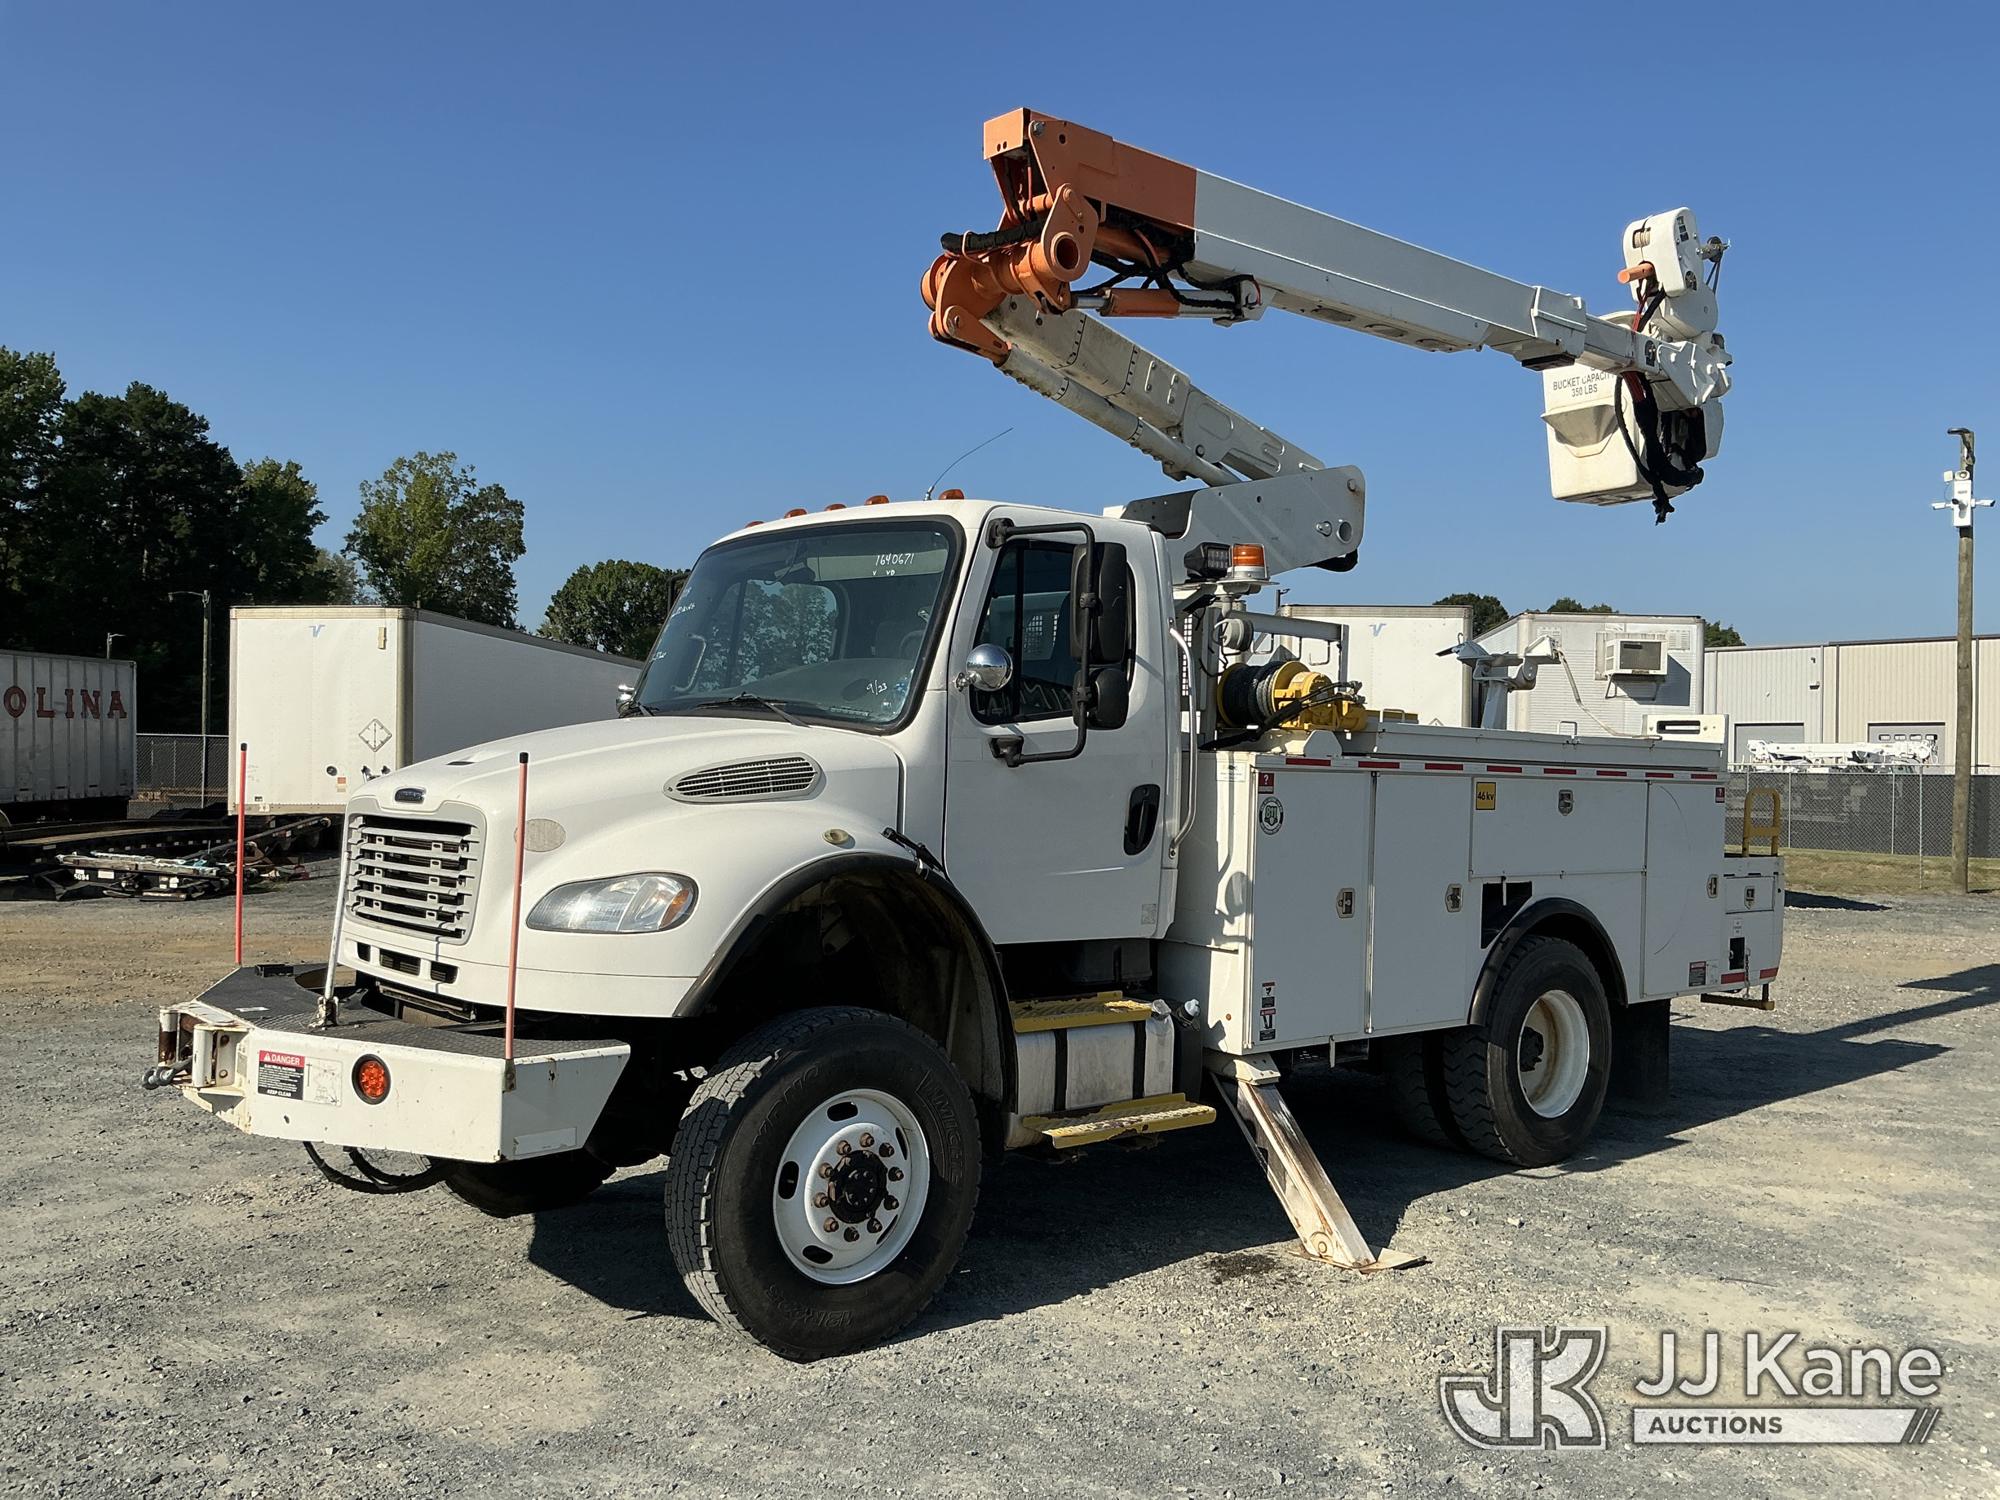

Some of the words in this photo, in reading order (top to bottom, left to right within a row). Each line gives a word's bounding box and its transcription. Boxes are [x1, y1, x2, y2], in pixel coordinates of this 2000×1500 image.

[1552, 376, 1580, 391] BUCKET
[1581, 371, 1614, 385] CAPACI
[1571, 386, 1583, 398] 350
[1584, 383, 1598, 395] LBS
[875, 552, 915, 566] 1640671
[866, 679, 888, 695] 9/23
[3, 685, 128, 719] OLINA
[1477, 791, 1485, 801] 46
[271, 1053, 300, 1066] DANGER
[278, 1090, 292, 1098] CLEAR
